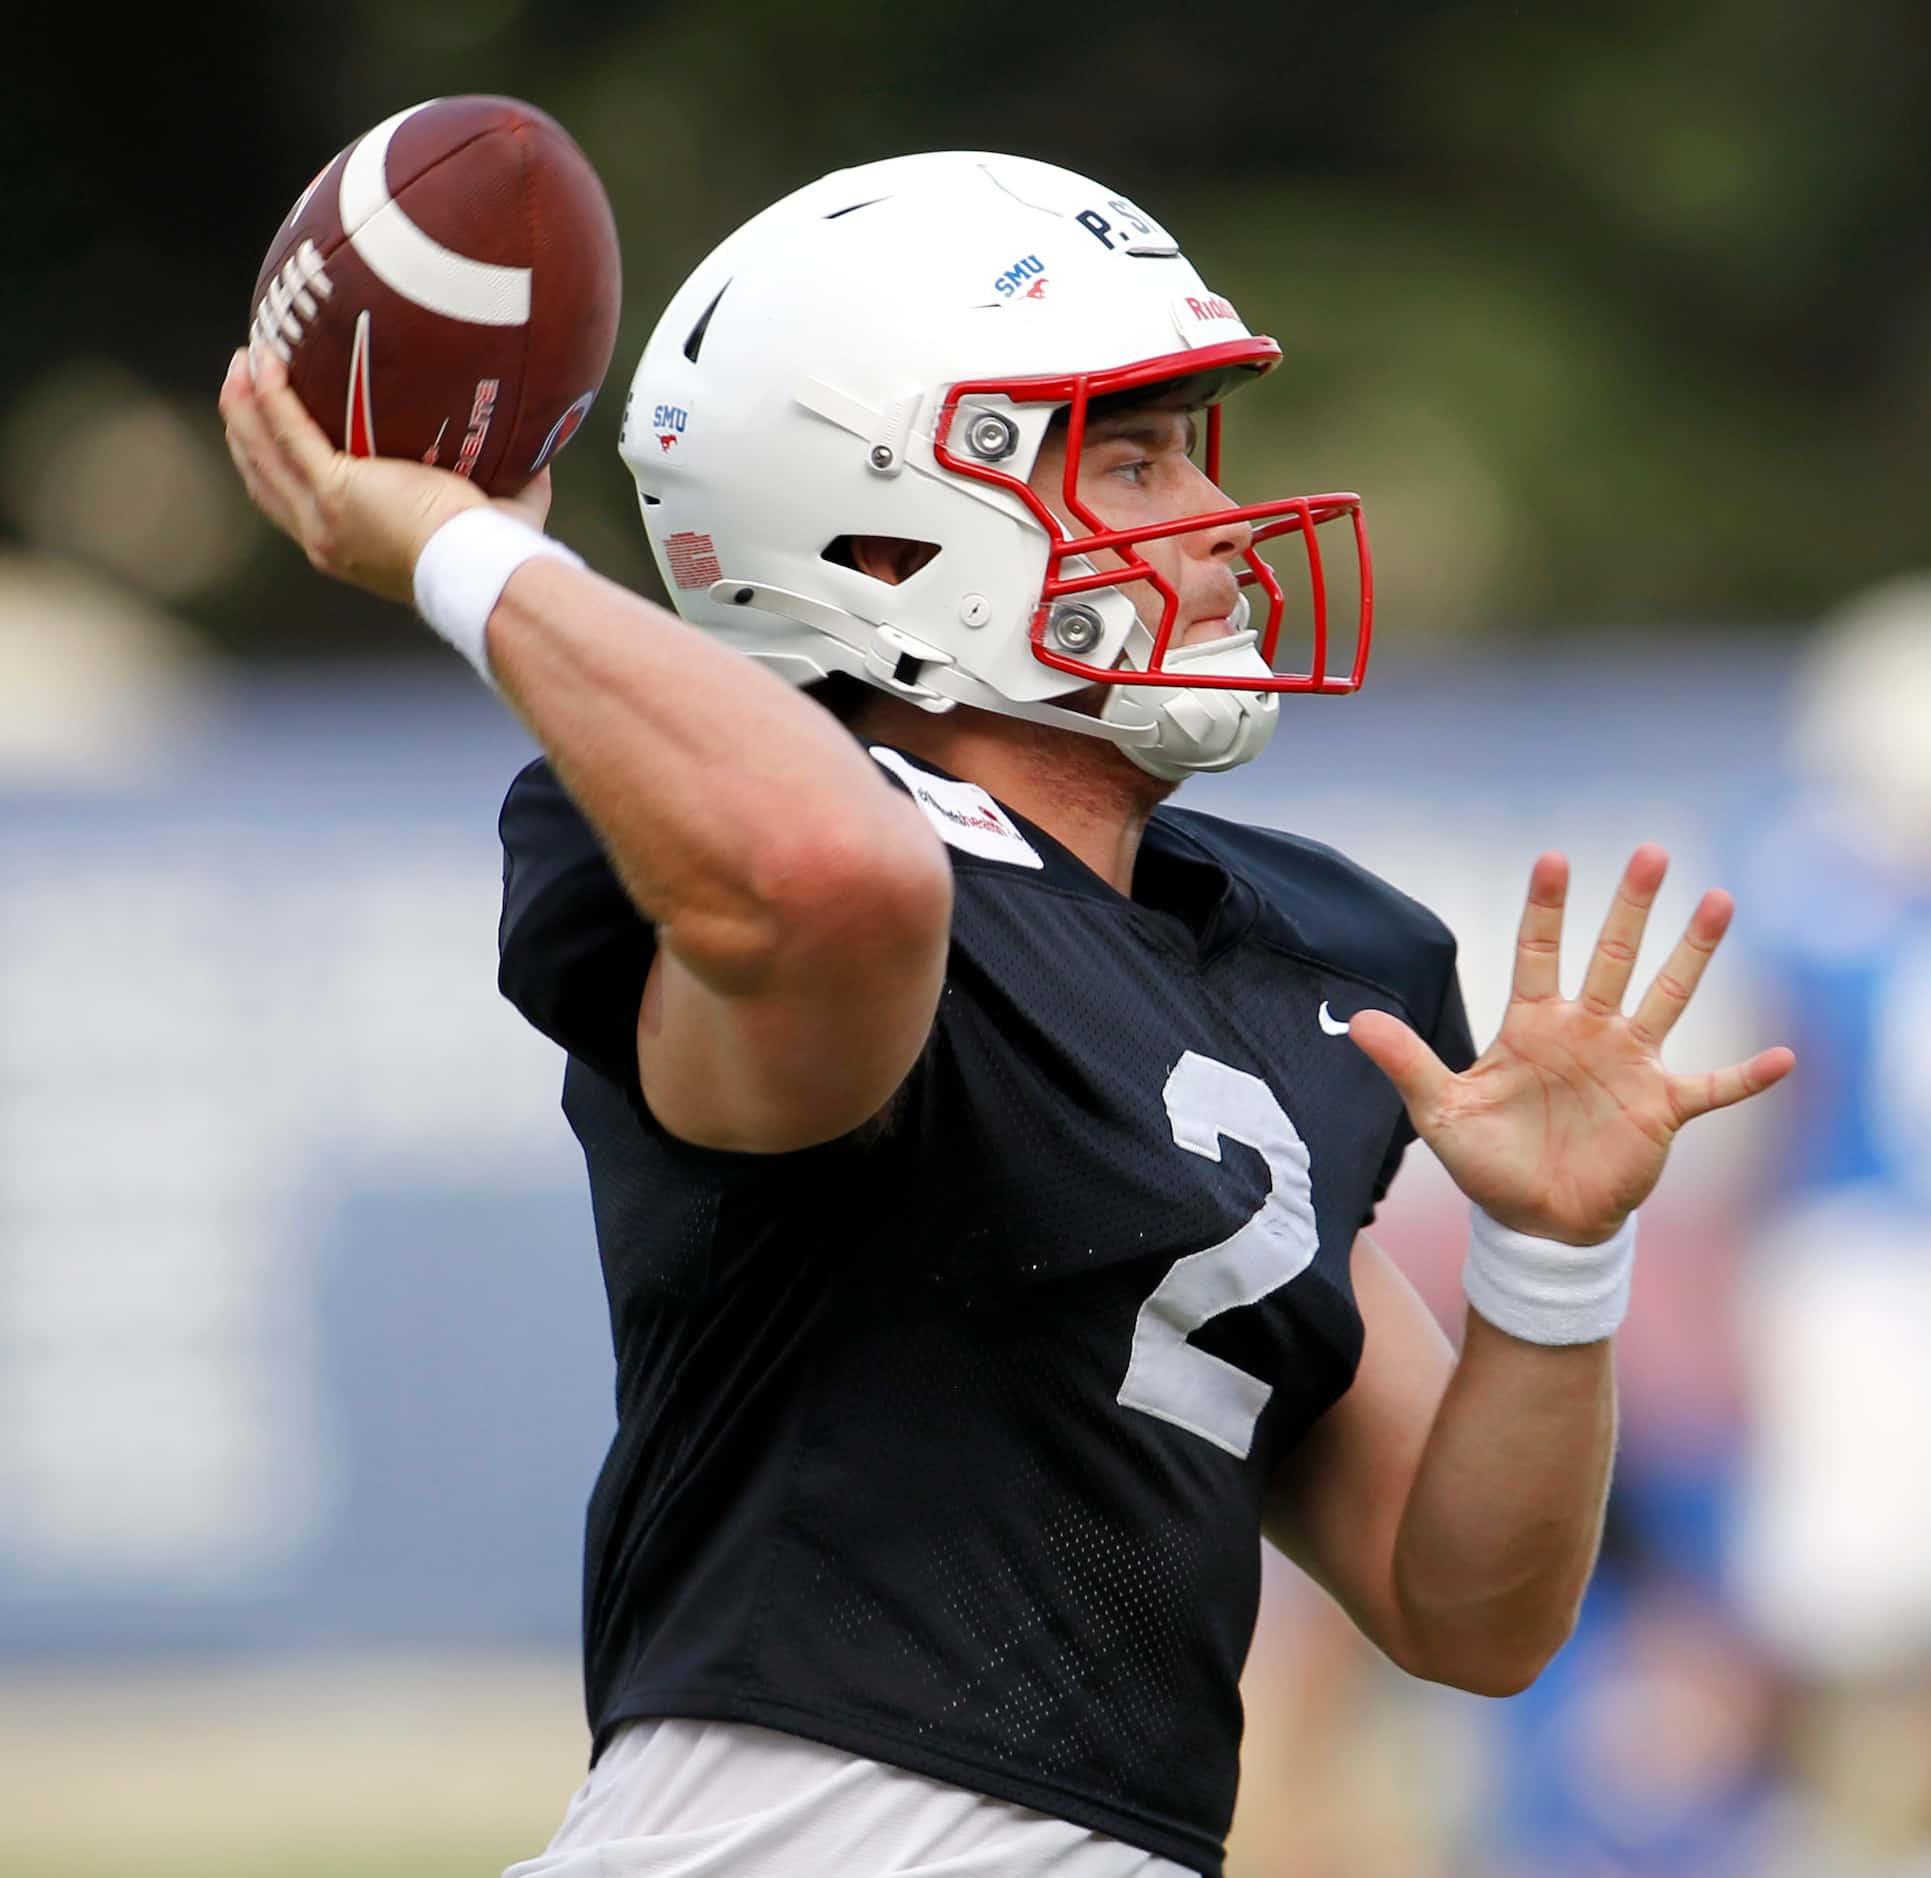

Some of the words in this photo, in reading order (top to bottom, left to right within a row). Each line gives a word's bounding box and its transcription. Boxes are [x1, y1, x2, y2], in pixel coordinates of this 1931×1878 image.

[1075, 200, 1159, 250] P.S
[994, 254, 1045, 298] SMU
[653, 405, 688, 433] SMU
[1117, 1069, 1320, 1461] 2
